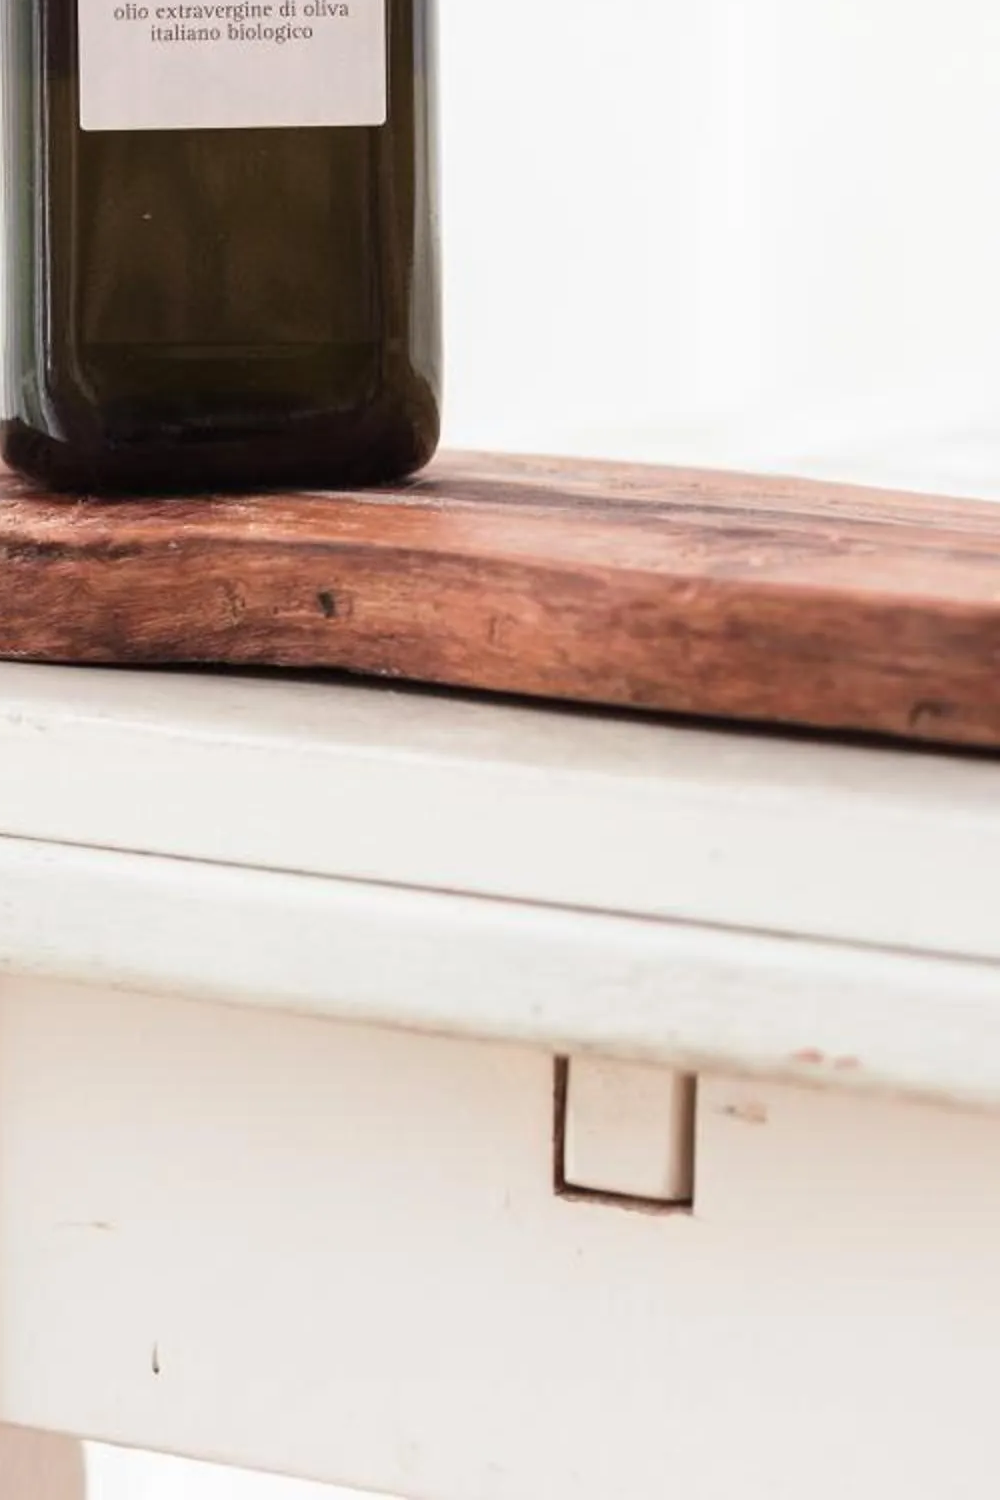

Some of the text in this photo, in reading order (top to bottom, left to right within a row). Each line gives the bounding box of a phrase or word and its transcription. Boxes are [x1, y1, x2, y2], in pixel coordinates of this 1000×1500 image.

[113, 0, 350, 21] olio extravergine di oliva
[150, 22, 314, 44] italiano biologico
